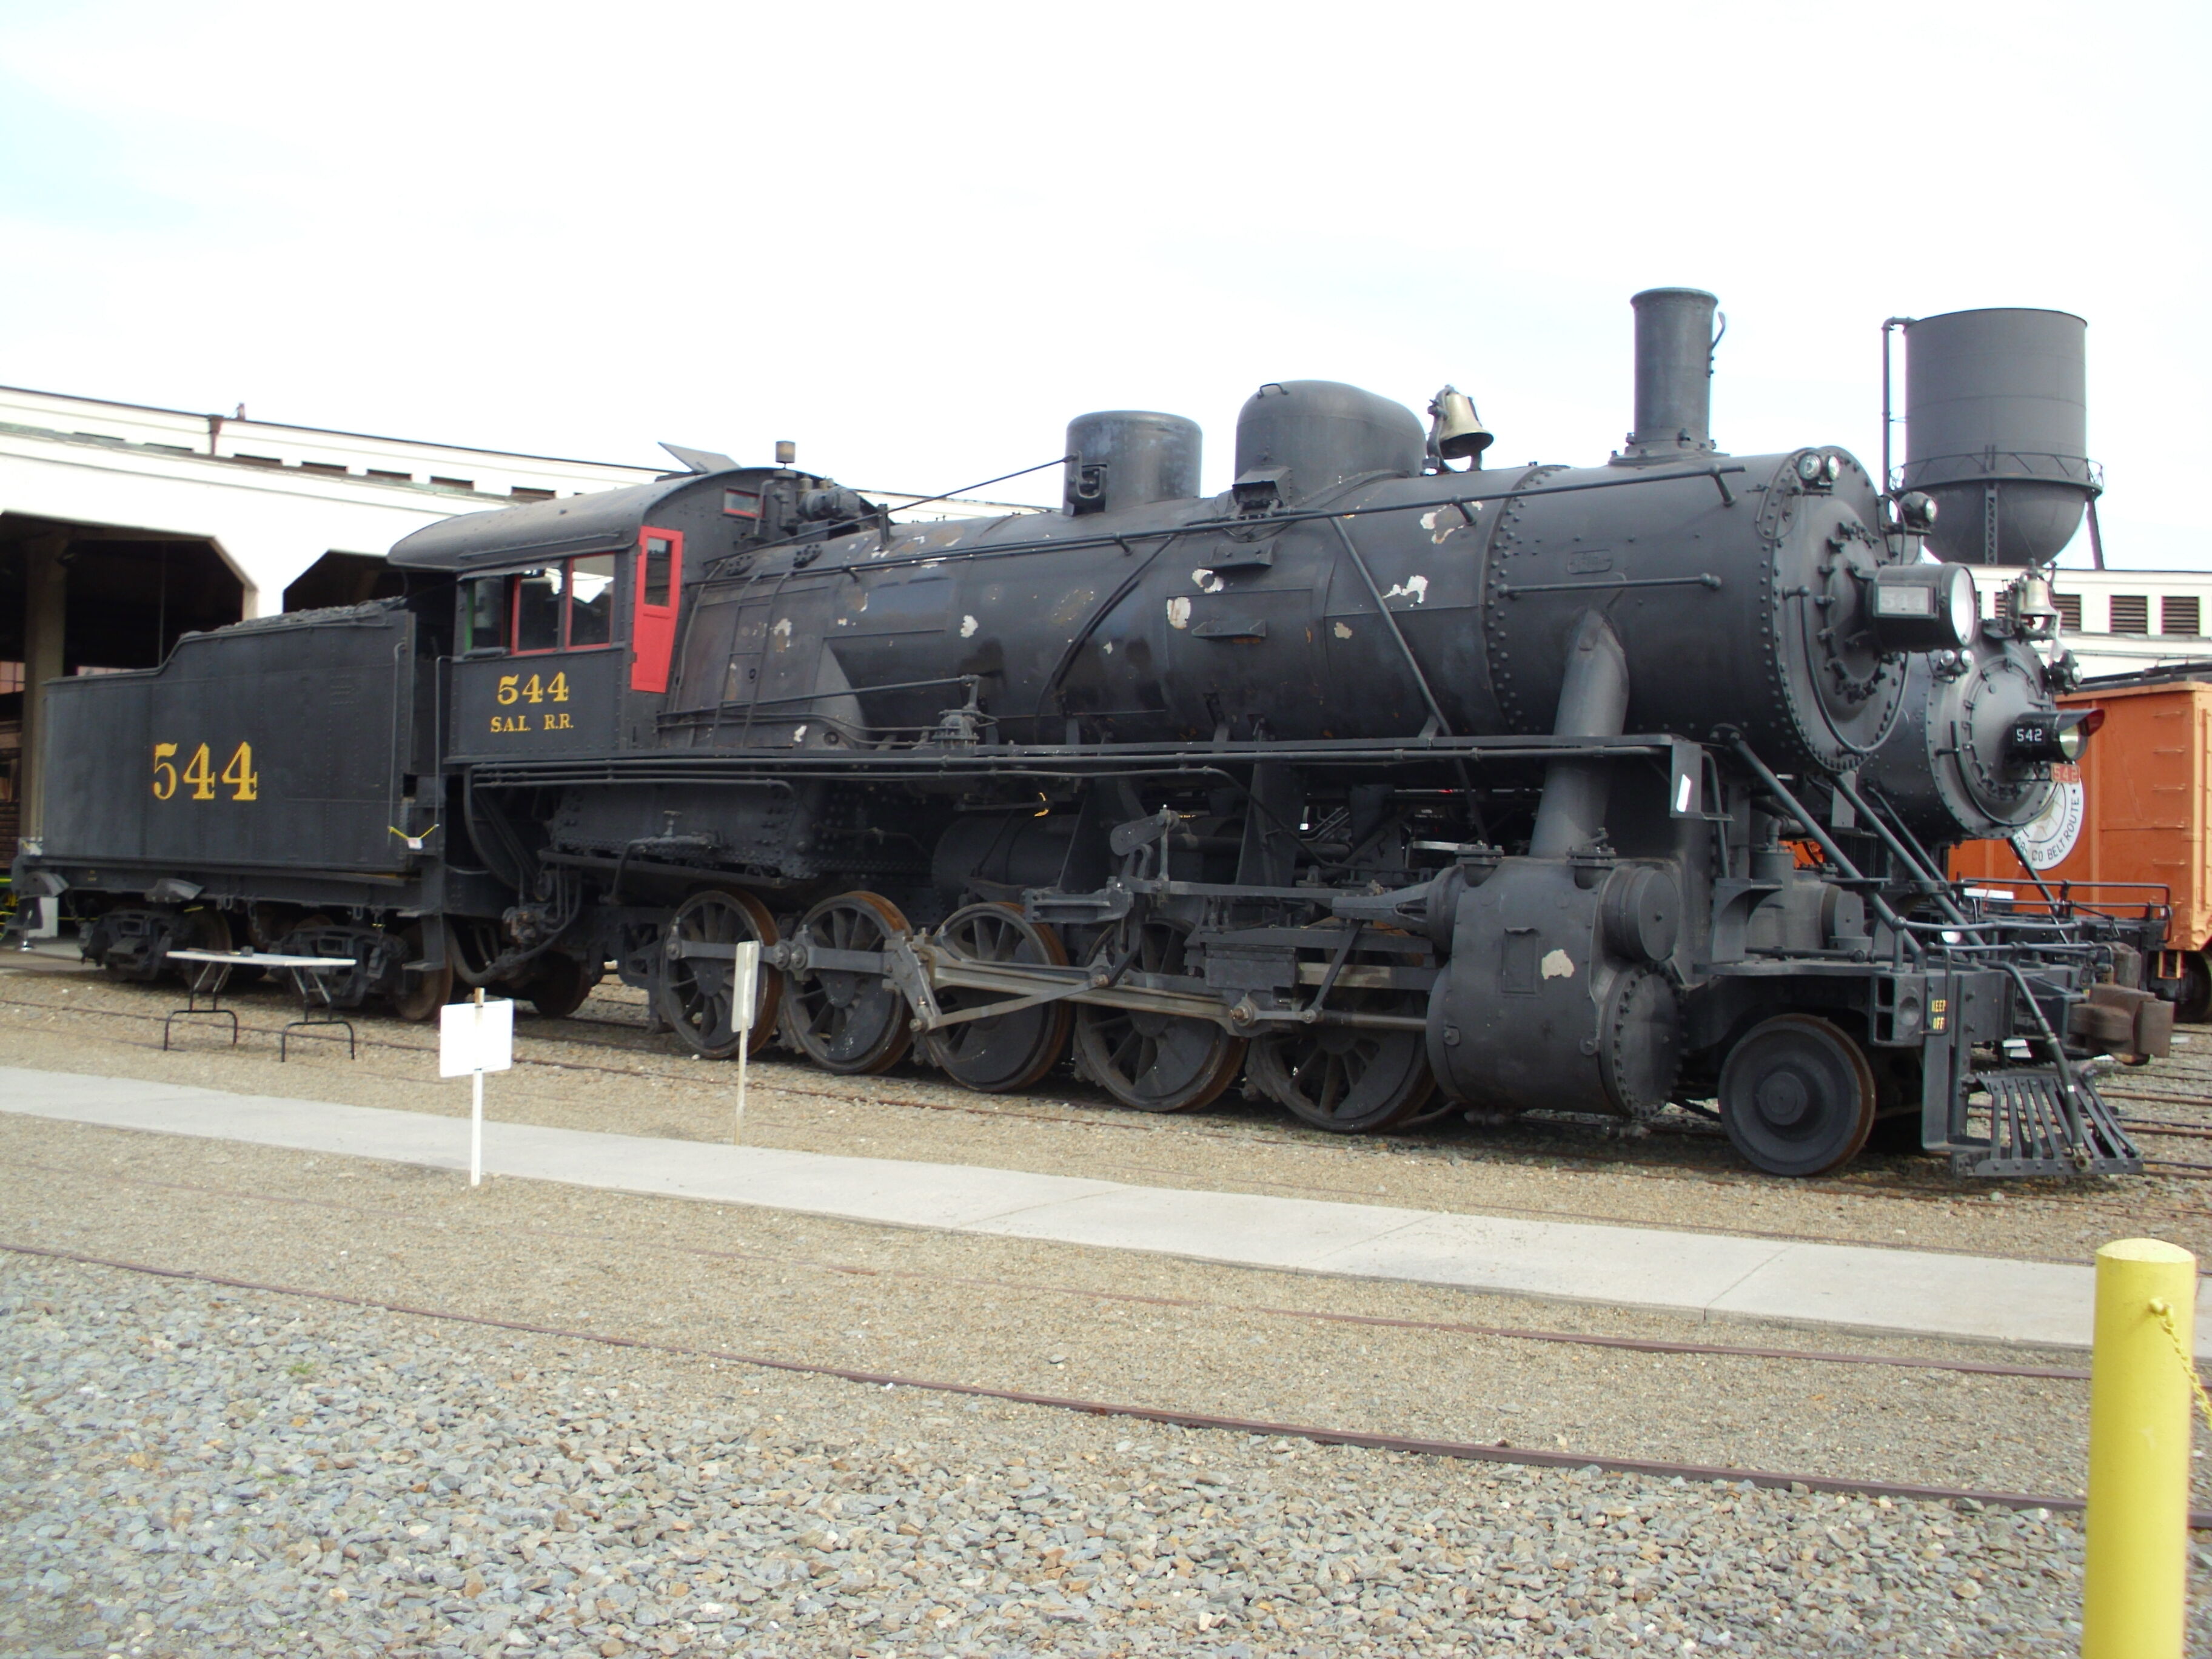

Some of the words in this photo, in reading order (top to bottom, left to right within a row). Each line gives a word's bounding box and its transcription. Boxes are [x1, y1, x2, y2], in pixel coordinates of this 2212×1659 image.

[497, 671, 569, 705] 544
[543, 713, 574, 730] R.R.
[2016, 728, 2042, 742] 542
[153, 741, 258, 800] 544
[2054, 766, 2078, 781] 542
[2031, 850, 2043, 862] CO
[2047, 840, 2065, 860] BELT
[2063, 797, 2080, 842] ROUTE
[1931, 999, 1946, 1012] KEEP
[1933, 1017, 1945, 1030] OFF
